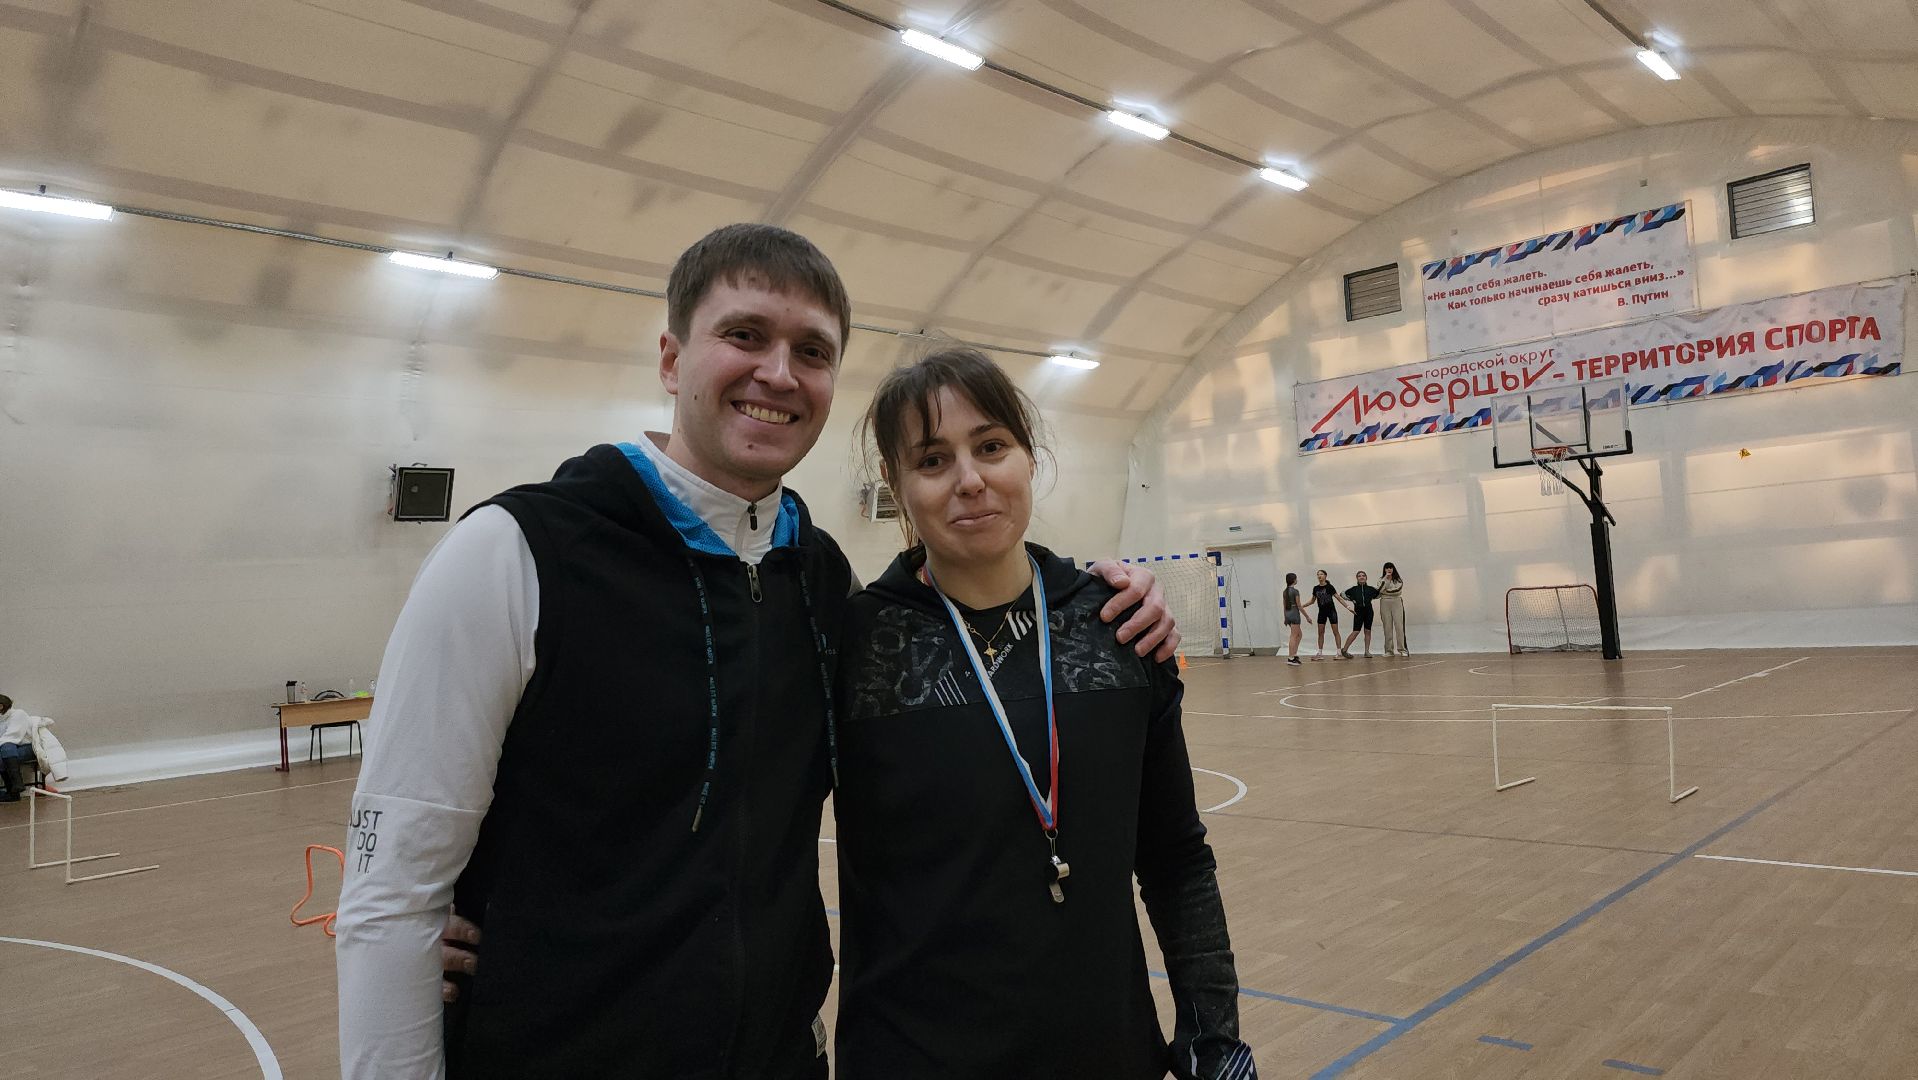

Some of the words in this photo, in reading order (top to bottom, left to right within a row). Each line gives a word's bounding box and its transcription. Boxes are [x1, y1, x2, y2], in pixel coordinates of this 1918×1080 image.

[1427, 291, 1446, 302] «Не
[1448, 286, 1473, 297] надо
[1476, 279, 1500, 292] себя
[1503, 270, 1547, 285] жалеть.
[1447, 300, 1467, 311] Как
[1469, 292, 1506, 306] только
[1508, 279, 1572, 297] начинаешь
[1575, 270, 1602, 284] себя
[1604, 261, 1654, 278] жалеть,
[1538, 292, 1570, 306] сразу
[1573, 280, 1631, 299] катишься
[1617, 297, 1629, 307] В.
[1632, 289, 1669, 305] Путин
[1311, 360, 1556, 433] Люберцы
[1572, 331, 1755, 380] ТЕРРИТОРИЯ
[1764, 316, 1881, 350] СПОРТА
[1425, 354, 1505, 379] городской
[1509, 348, 1555, 367] округ
[987, 642, 1014, 680] ARDWORK
[350, 809, 383, 831] UST
[357, 831, 377, 852] DO
